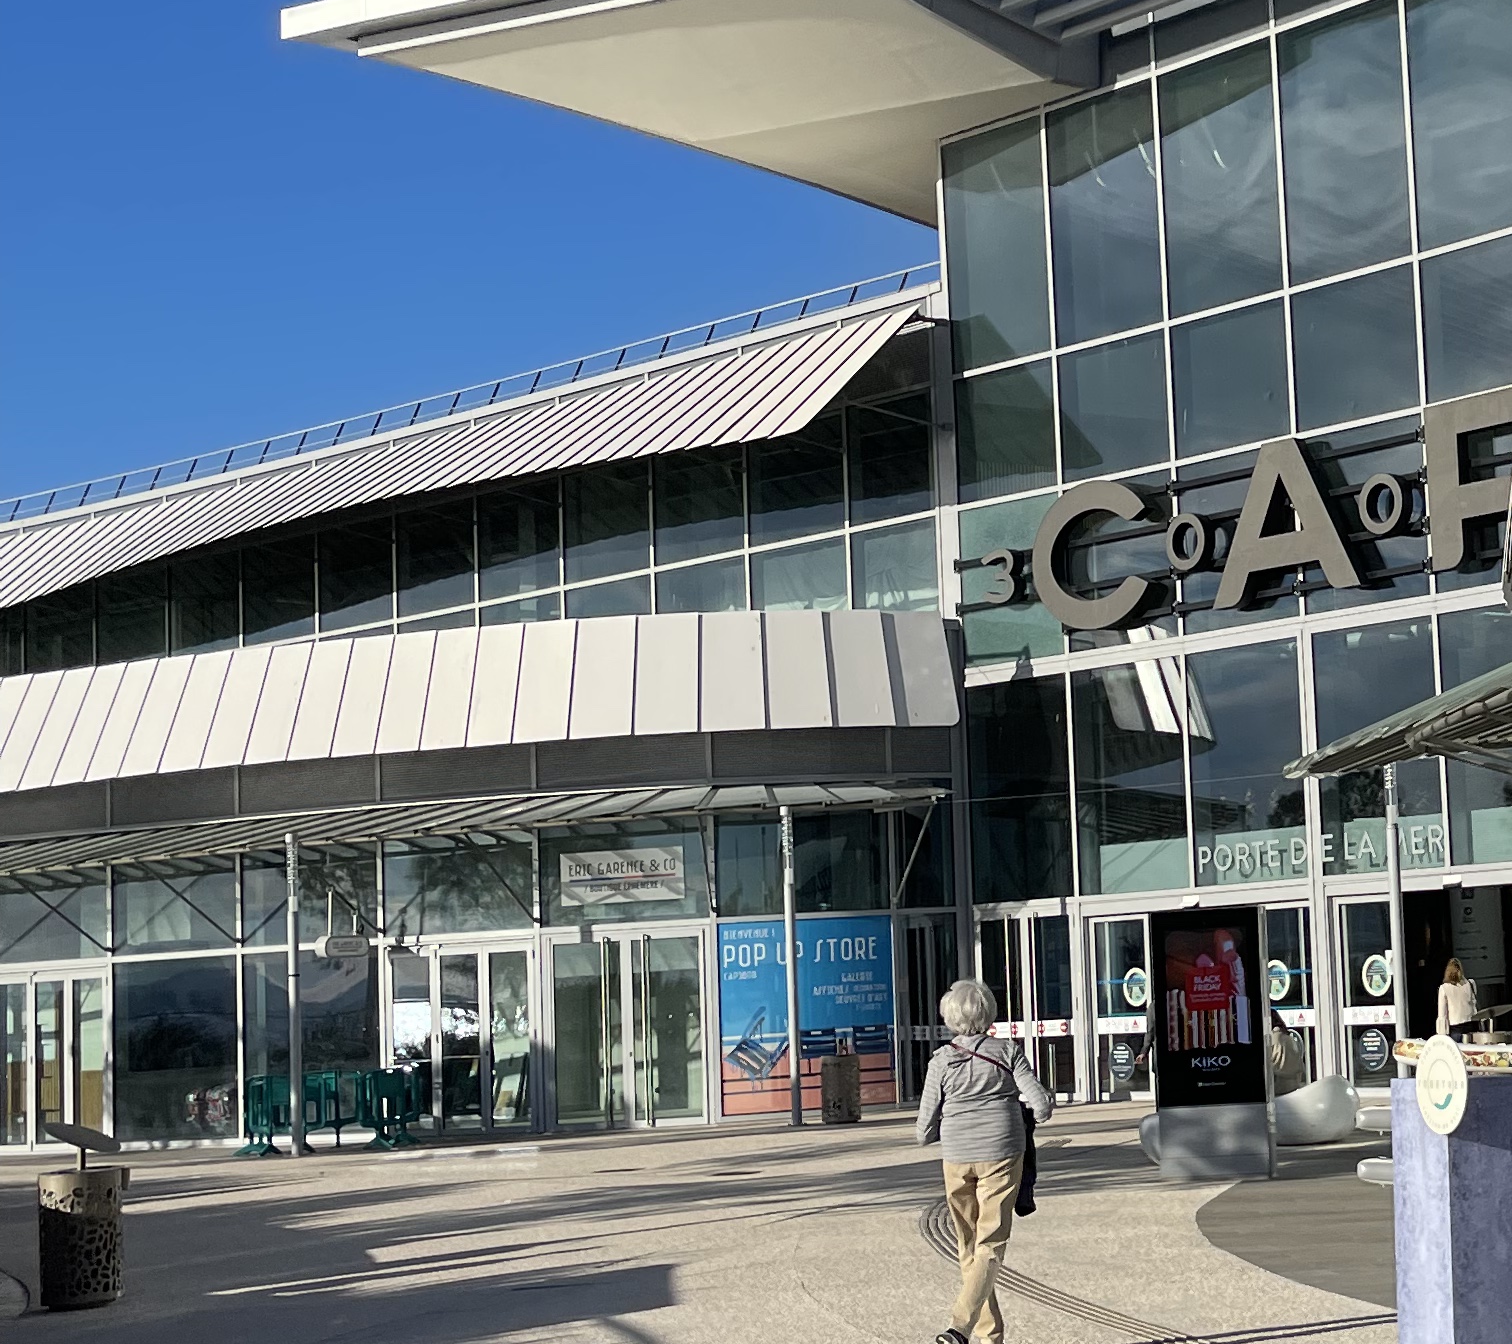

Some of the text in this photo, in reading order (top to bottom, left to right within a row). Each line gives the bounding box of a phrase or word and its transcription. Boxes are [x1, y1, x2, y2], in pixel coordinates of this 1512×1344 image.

[1198, 838, 1281, 874] PORTE
[1343, 830, 1377, 861] LA
[568, 857, 677, 878] ERIC GARENCE & CO
[723, 942, 767, 969] POP
[813, 936, 878, 963] STORE
[1193, 975, 1222, 984] BLACK
[1193, 983, 1222, 992] FRIDAY
[1191, 1055, 1231, 1068] KIKO
